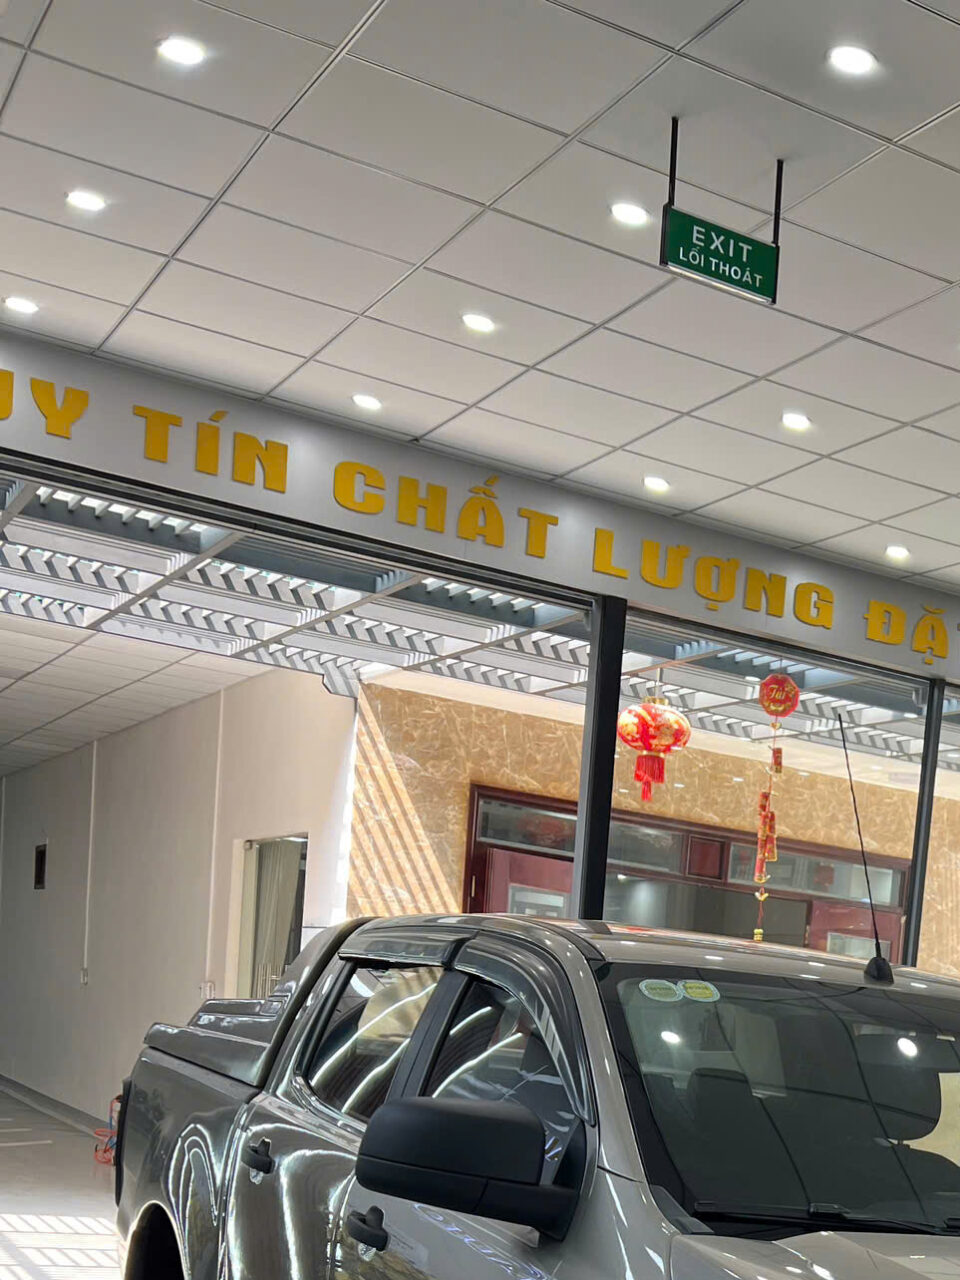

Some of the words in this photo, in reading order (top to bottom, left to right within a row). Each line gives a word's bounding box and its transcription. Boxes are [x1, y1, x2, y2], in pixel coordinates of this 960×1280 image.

[692, 225, 752, 262] EXIT
[709, 257, 762, 288] THOÁT
[133, 405, 288, 494] TÍN
[333, 461, 560, 560] CHẤT
[593, 528, 836, 631] LƯỢNG
